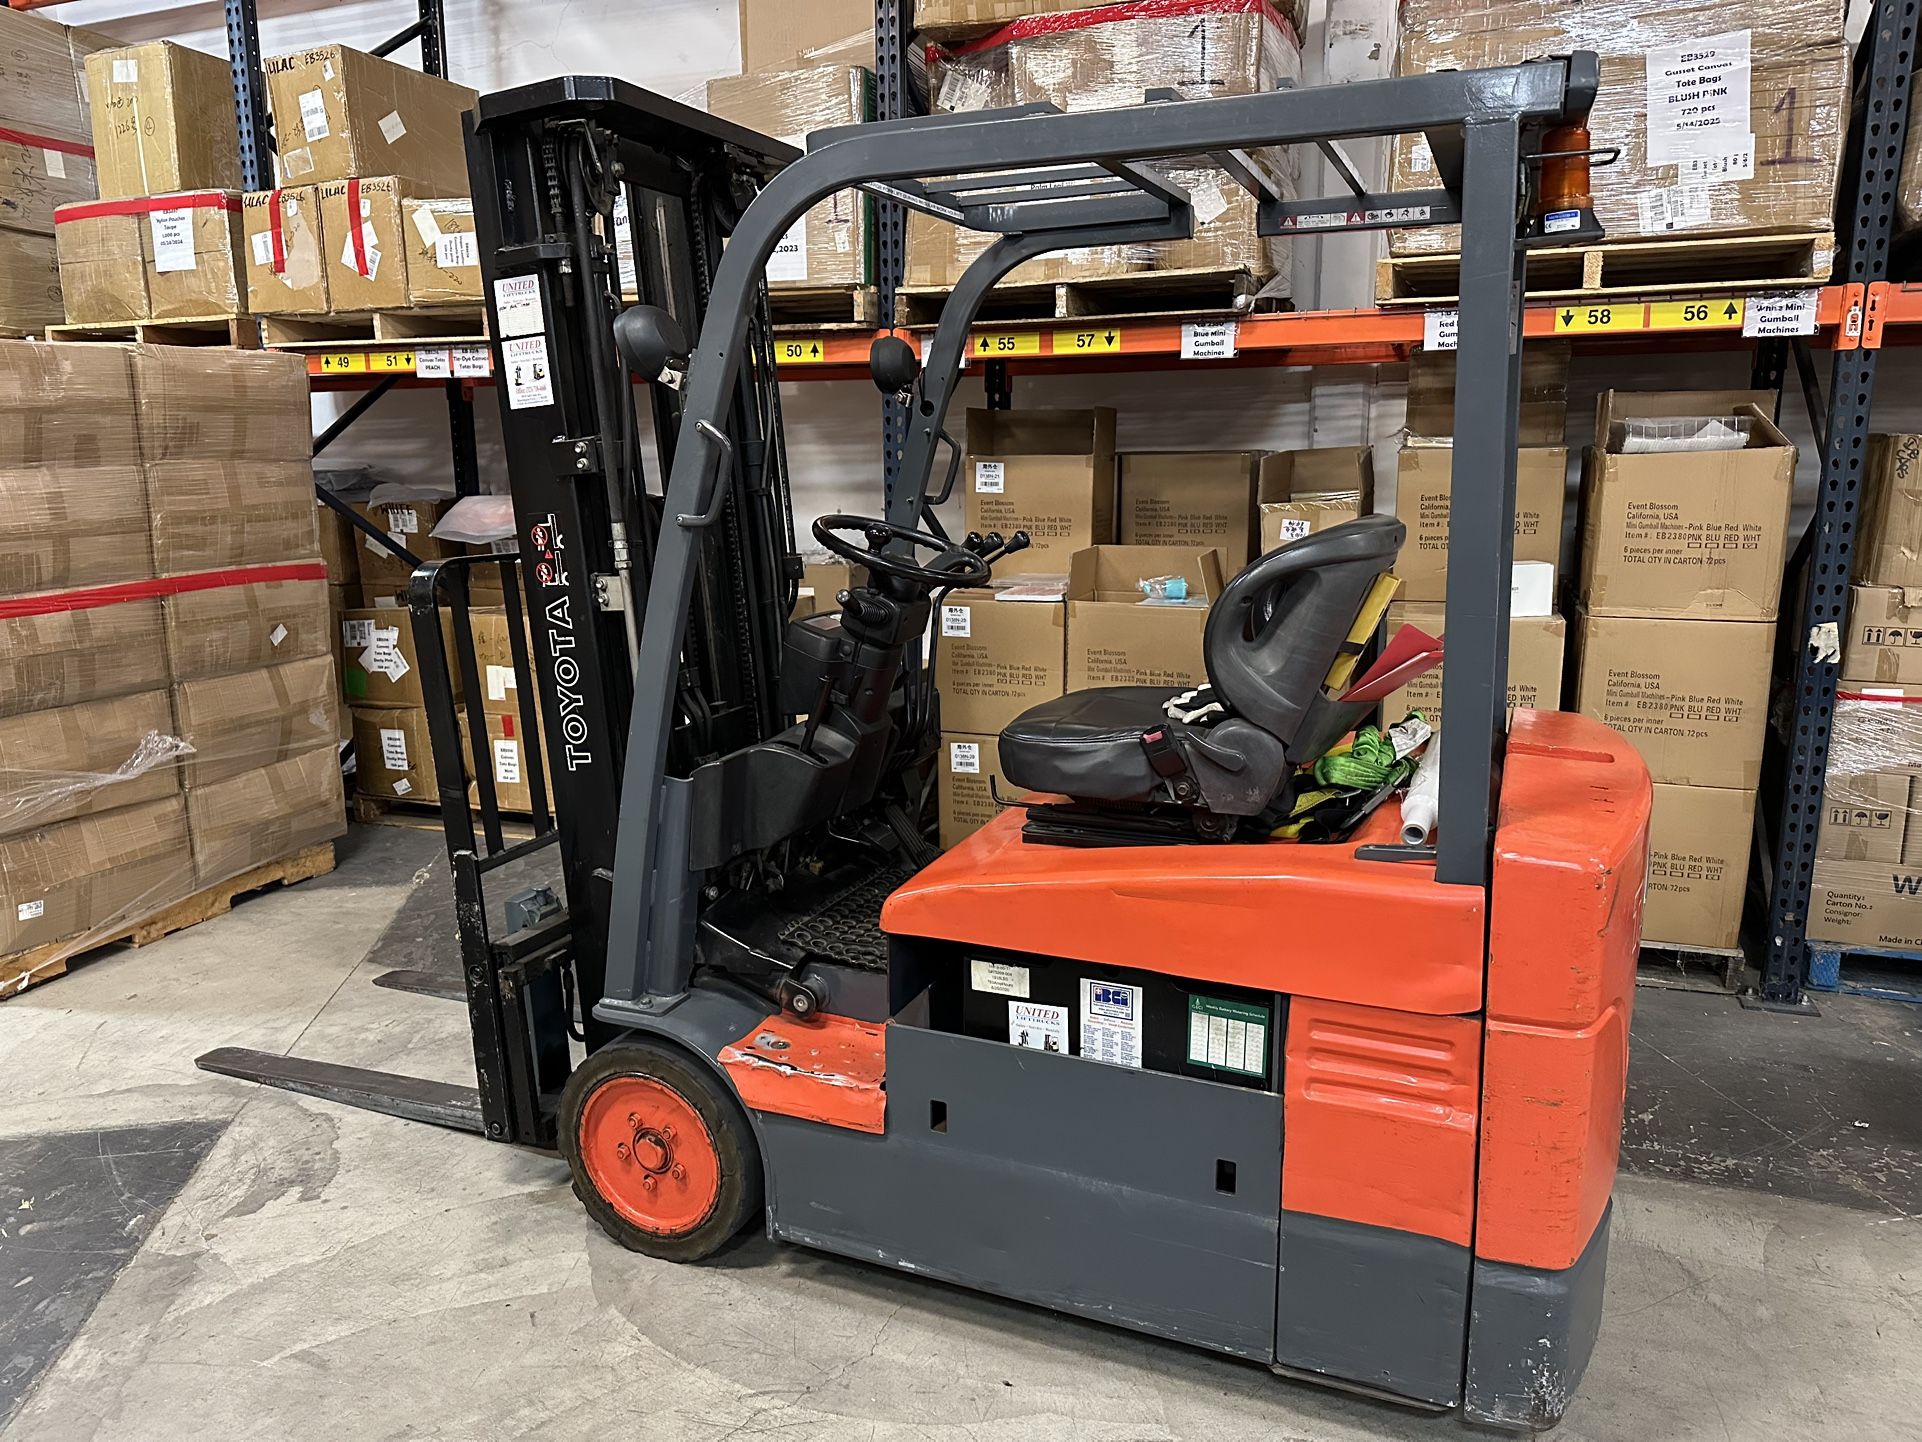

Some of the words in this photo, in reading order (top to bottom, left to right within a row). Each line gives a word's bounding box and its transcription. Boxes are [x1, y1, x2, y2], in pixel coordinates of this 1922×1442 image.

[268, 56, 295, 75] LILAC
[304, 50, 335, 66] EB3526
[1665, 66, 1696, 77] Gusset
[1697, 61, 1732, 72] Canvas
[1676, 79, 1697, 88] Tote
[1699, 75, 1722, 86] Bags
[1668, 89, 1701, 104] BLUSH
[1702, 86, 1728, 99] PINK
[1681, 106, 1699, 116] 720
[1700, 104, 1716, 115] pcs
[1760, 87, 1822, 166] 1
[321, 185, 345, 200] LILAC
[361, 183, 392, 194] EB3526
[244, 195, 269, 208] LILAC
[502, 280, 534, 293] UNITED
[1785, 303, 1806, 311] Mini
[1587, 309, 1611, 325] 58
[1684, 305, 1709, 321] 56
[1760, 314, 1799, 323] Gumball
[1210, 329, 1226, 337] Mini
[1757, 326, 1799, 334] Machines
[997, 338, 1015, 351] 55
[1076, 334, 1095, 347] 57
[1194, 339, 1225, 347] Gumball
[509, 340, 542, 353] UNITED
[787, 345, 802, 357] 50
[338, 356, 350, 368] 49
[386, 355, 398, 366] 51
[1420, 494, 1438, 502] Event
[1627, 502, 1647, 510] Event
[1648, 502, 1679, 511] Blossom
[1626, 512, 1662, 520] California,
[1663, 512, 1679, 520] USA
[1638, 522, 1660, 530] Gumball
[1660, 522, 1684, 530] Machines
[1706, 523, 1722, 531] Blue
[1724, 523, 1739, 531] Red
[1742, 523, 1762, 532] White
[1625, 531, 1643, 539] Item
[1656, 532, 1687, 540] EB2380
[1687, 533, 1703, 541] PNK
[1705, 533, 1721, 542] BLU
[1723, 533, 1740, 542] RED
[1743, 534, 1762, 542] WHT
[1419, 542, 1439, 550] TOTAL
[1629, 546, 1651, 554] pieces
[1623, 555, 1646, 564] TOTAL
[1647, 556, 1661, 564] QTY
[1663, 556, 1671, 564] IN
[1705, 557, 1726, 566] 72pcs
[1103, 649, 1127, 657] Blossom
[1162, 670, 1174, 678] Red
[1176, 671, 1191, 679] White
[1608, 669, 1629, 678] Event
[1630, 670, 1661, 680] Blossom
[546, 595, 592, 772] TOYOTA
[1135, 677, 1147, 685] PNK
[1607, 679, 1642, 689] California,
[1644, 681, 1661, 690] USA
[1519, 684, 1537, 693] White
[1406, 691, 1423, 699] Item
[1519, 694, 1537, 703] WHT
[1606, 689, 1618, 697] Mini
[1618, 690, 1640, 699] Gumball
[1688, 695, 1705, 703] Blue
[1706, 696, 1721, 704] Red
[1724, 697, 1744, 706] White
[1605, 699, 1623, 708] Item
[1669, 703, 1685, 712] PNK
[1687, 704, 1703, 713] BLU
[1705, 705, 1721, 714] RED
[1723, 706, 1742, 715] WHT
[1609, 715, 1631, 723] pieces
[1632, 716, 1645, 725] per
[1645, 717, 1664, 725] inner
[1627, 725, 1643, 734] QTY
[1644, 726, 1652, 734] IN
[1653, 727, 1685, 737] CARTON
[1686, 729, 1708, 738] 72pcs
[1671, 853, 1687, 862] Blue
[1688, 854, 1703, 863] Red
[1705, 856, 1724, 865] White
[1652, 861, 1668, 869] PNK
[1670, 863, 1685, 871] BLU
[1687, 864, 1703, 872] RED
[1706, 866, 1724, 874] WHT
[1670, 884, 1690, 893] 72pcs
[1827, 890, 1865, 901] Quantity:
[1826, 899, 1854, 909] Carton
[1824, 908, 1863, 918] Consignor:
[1823, 916, 1852, 925] Weight:
[1879, 935, 1902, 944] Made
[1904, 937, 1913, 945] in
[1015, 1005, 1060, 1020] UNITED
